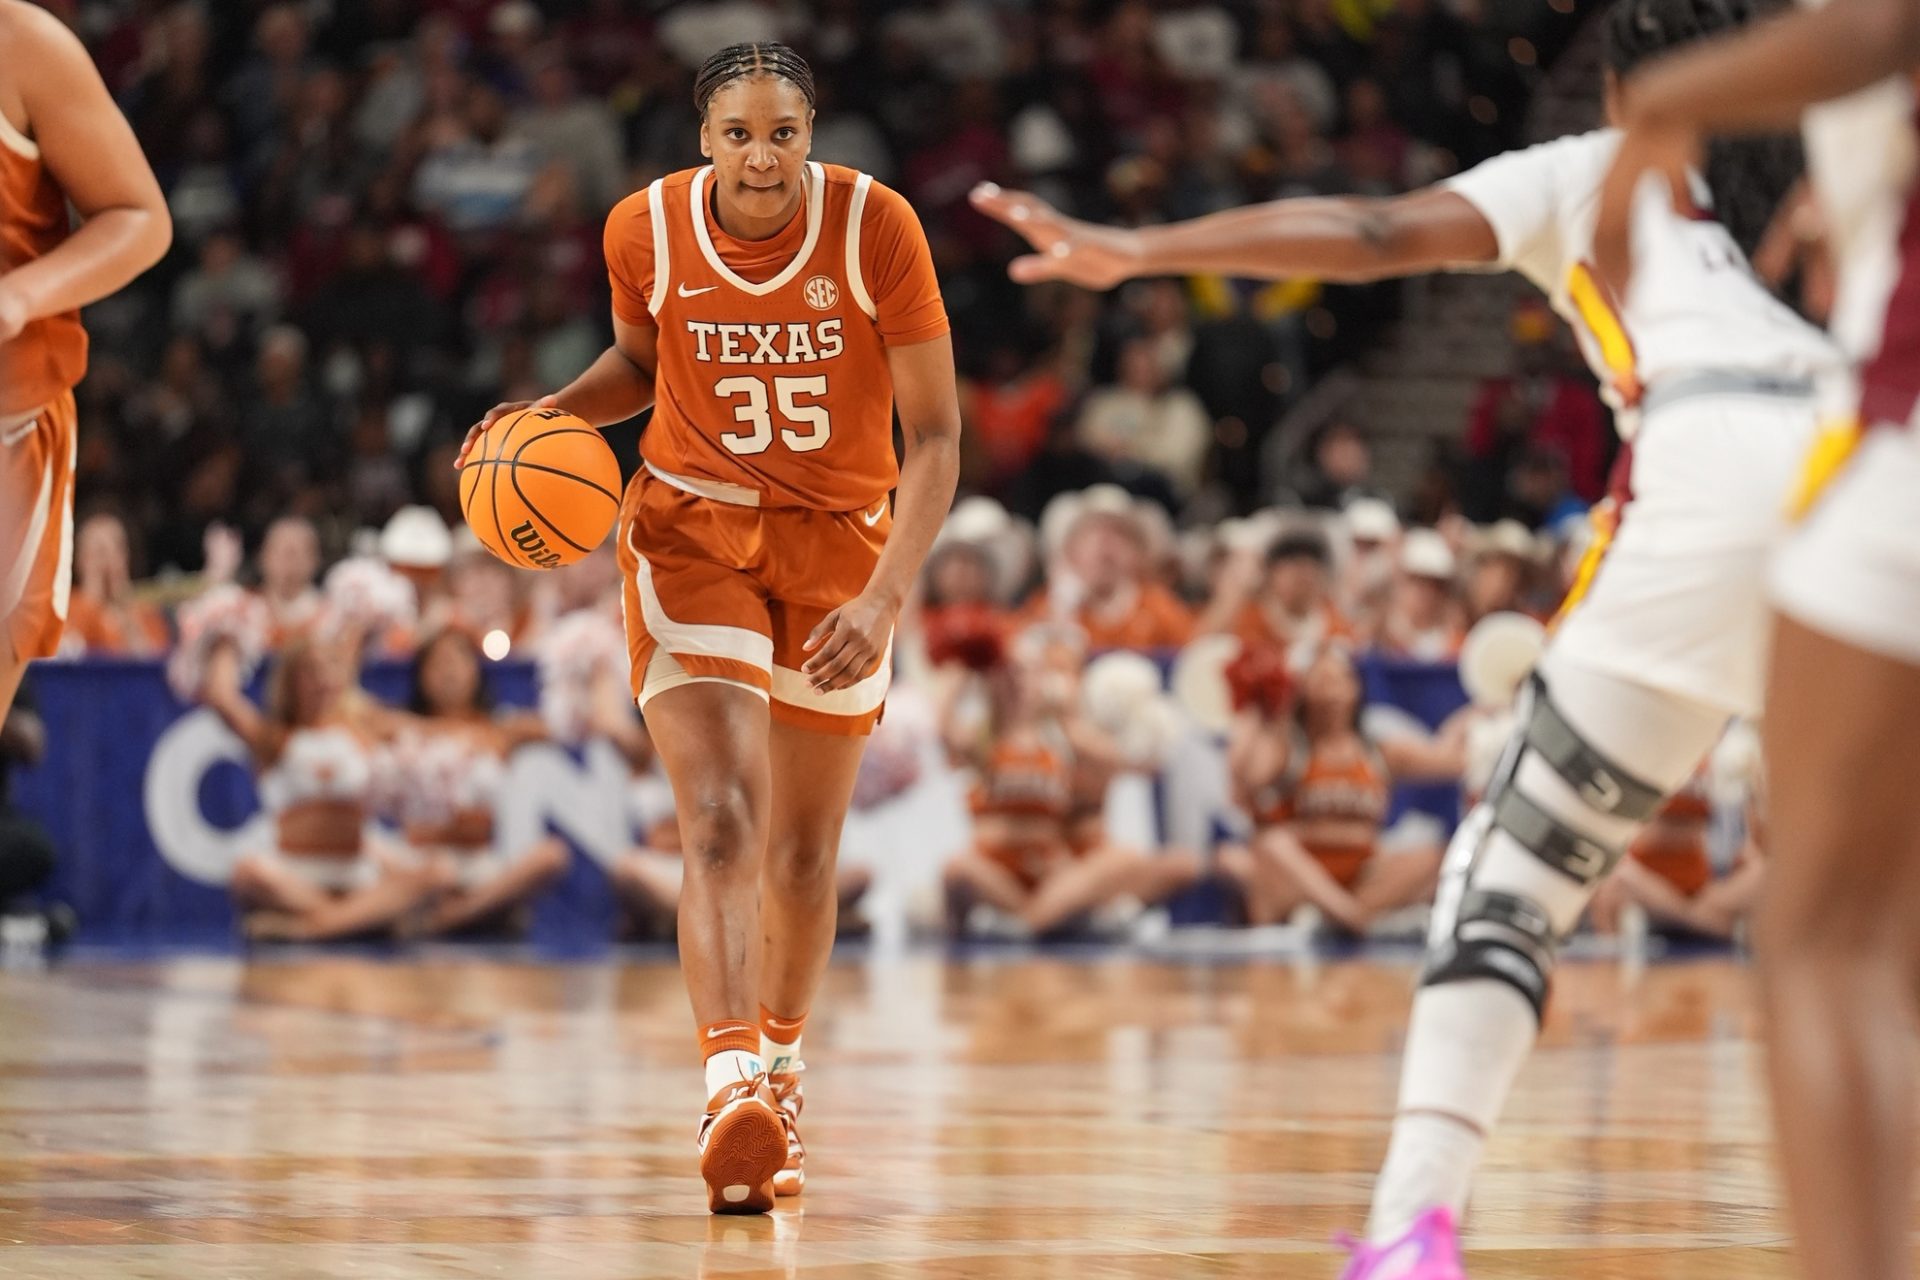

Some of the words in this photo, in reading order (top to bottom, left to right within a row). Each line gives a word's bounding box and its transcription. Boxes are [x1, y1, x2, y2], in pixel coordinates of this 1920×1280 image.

[806, 278, 837, 308] SEC
[687, 319, 844, 365] TEXAS
[713, 375, 831, 455] 35
